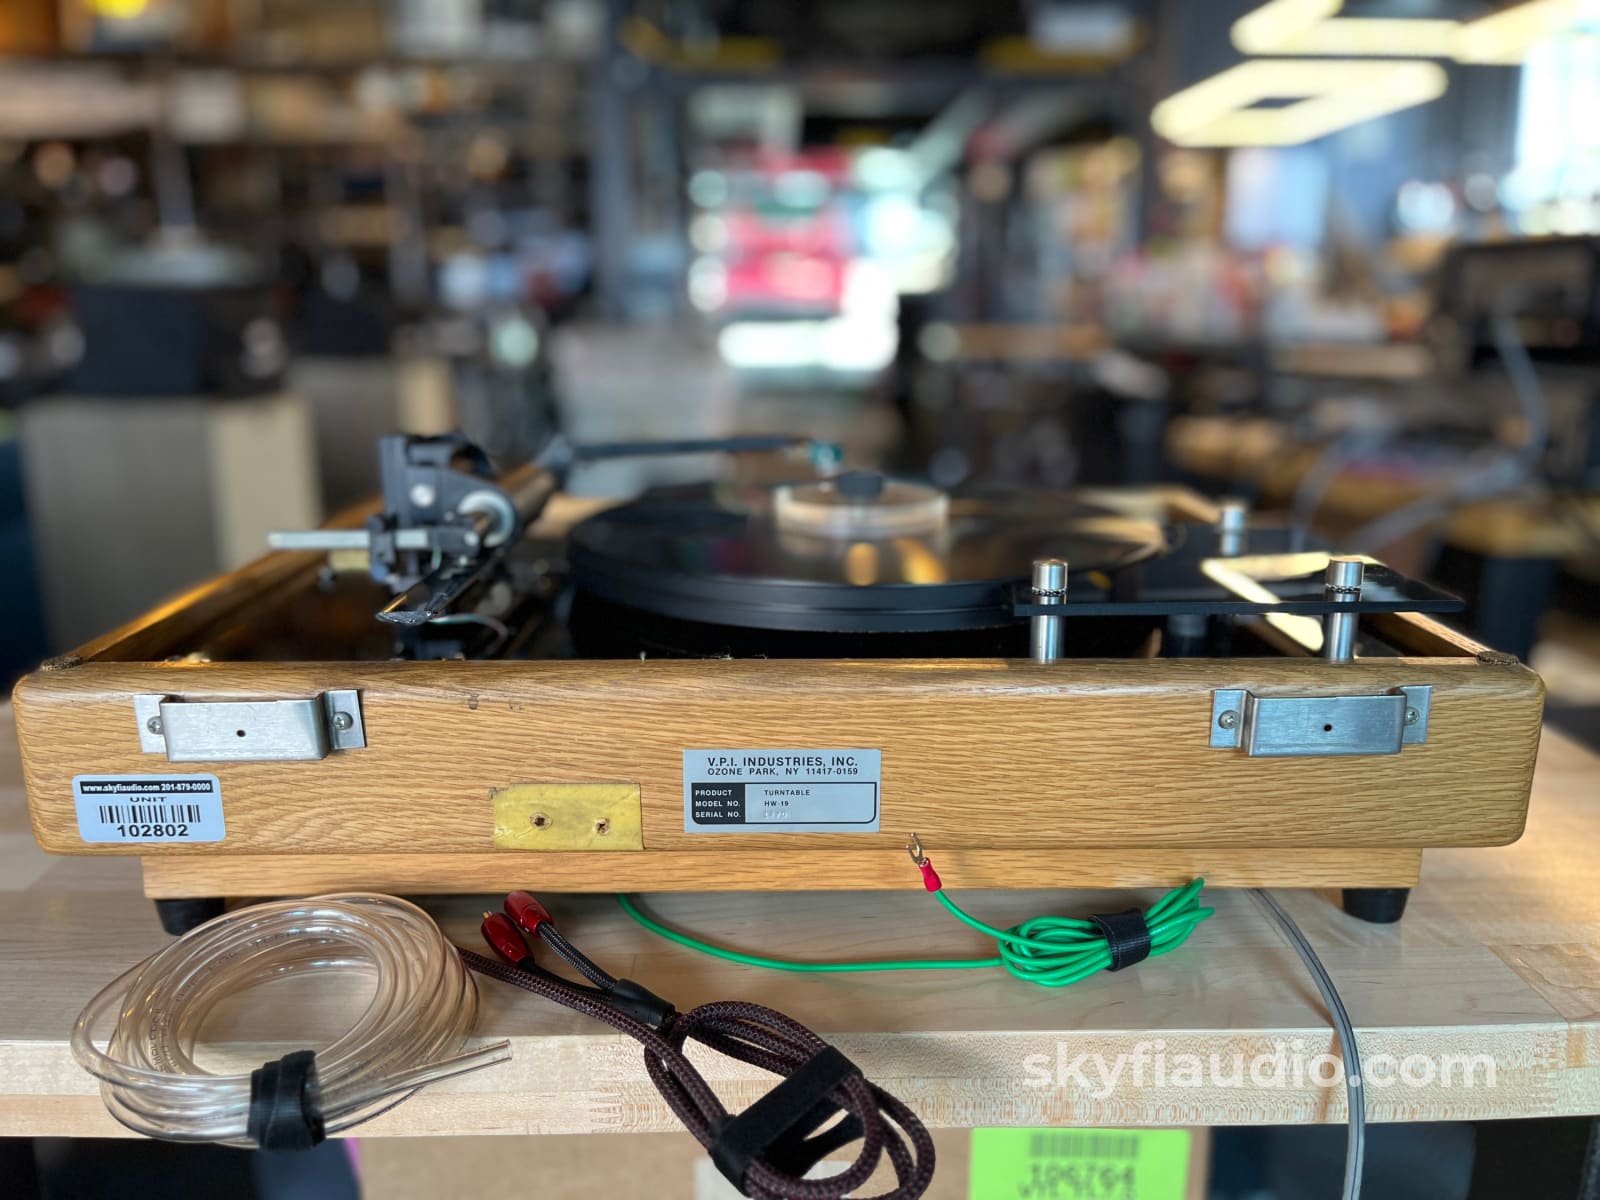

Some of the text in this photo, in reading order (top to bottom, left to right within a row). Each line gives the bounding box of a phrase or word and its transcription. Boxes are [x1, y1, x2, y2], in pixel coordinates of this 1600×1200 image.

[707, 756, 858, 768] V.P.I. INDUSTRIES, INC.
[707, 768, 743, 776] OZONE
[749, 768, 779, 777] PARK,
[805, 767, 858, 776] 11417-0159
[82, 784, 160, 794] www.skyfiaudio.com
[117, 824, 189, 837] 102802
